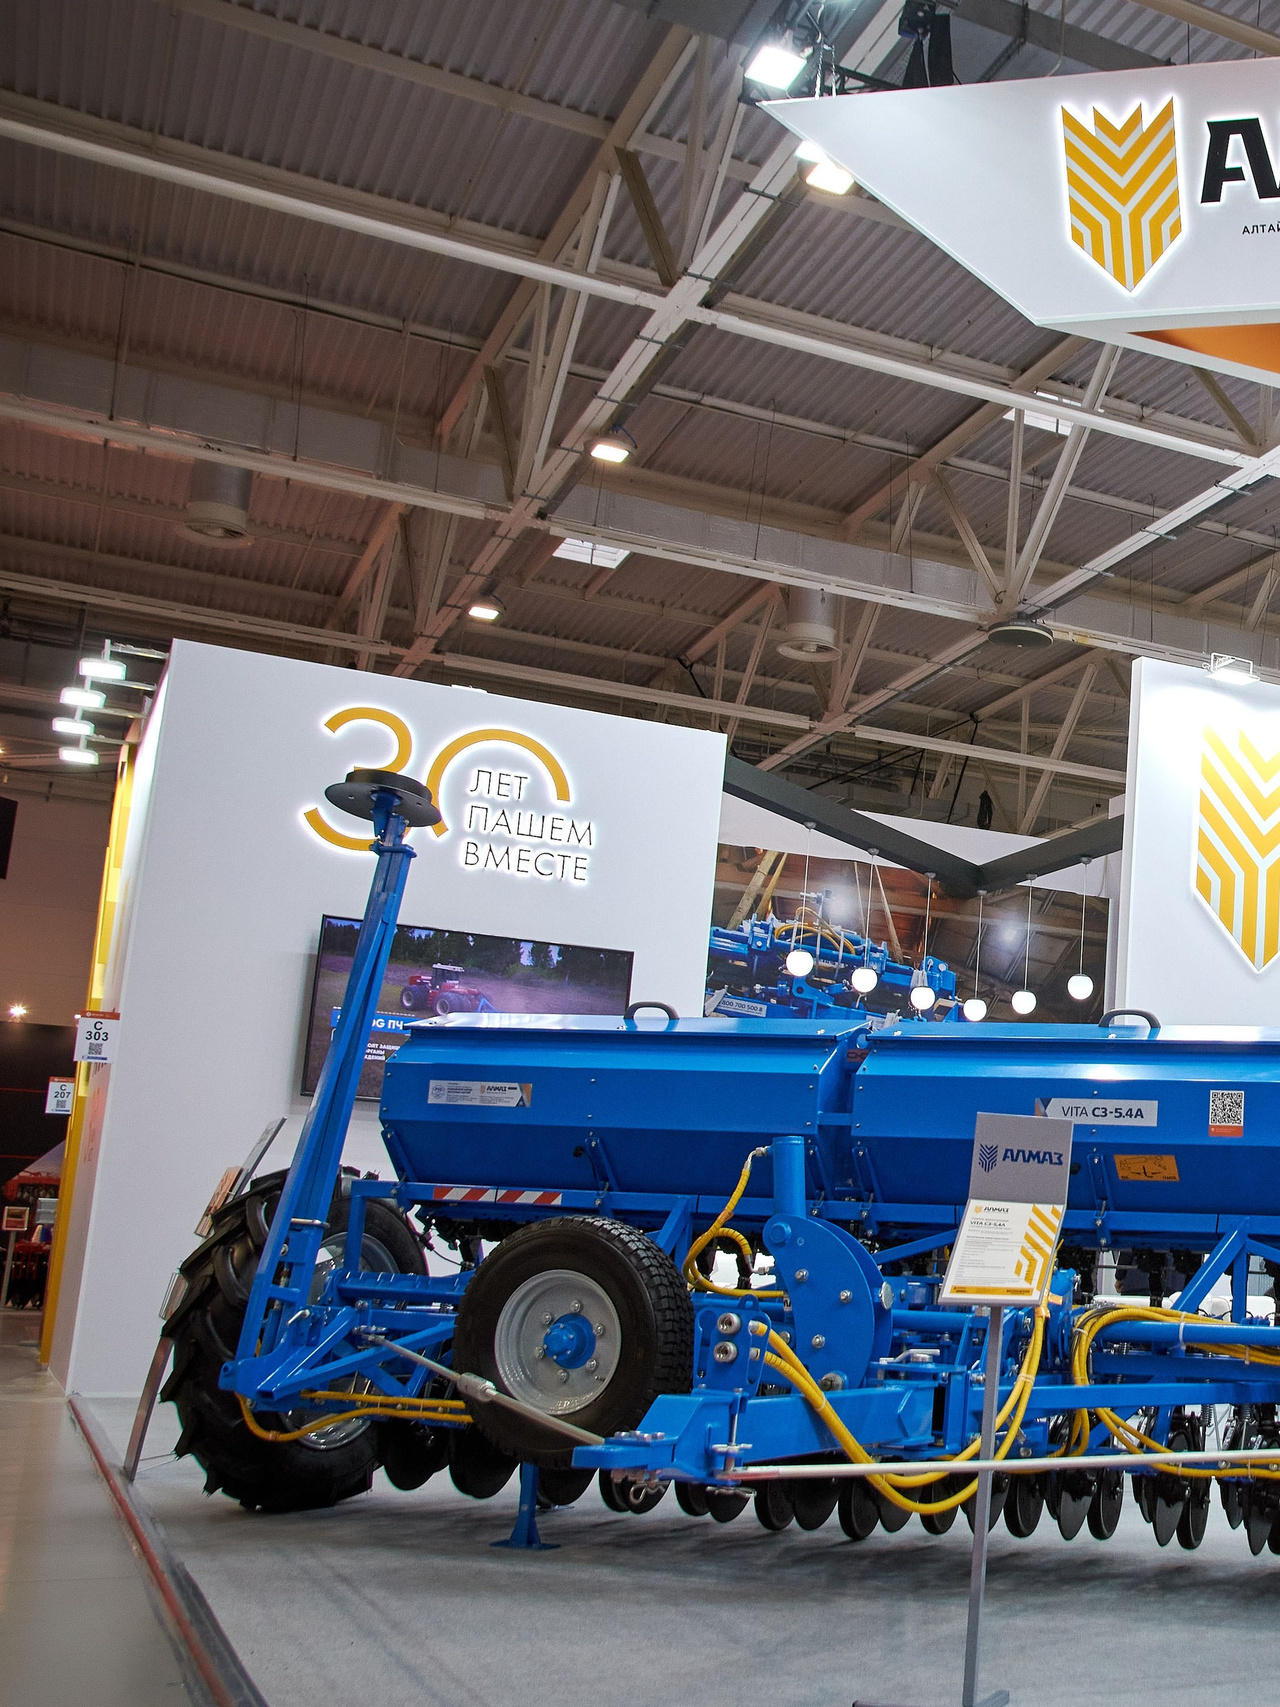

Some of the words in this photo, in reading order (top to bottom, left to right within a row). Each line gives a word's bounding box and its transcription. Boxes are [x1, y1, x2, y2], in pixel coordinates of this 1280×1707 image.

[469, 769, 529, 801] ЛЕТ
[468, 805, 593, 846] ПАШЕМ
[464, 842, 588, 881] ВМЕСТЕ
[85, 1031, 109, 1042] 303
[54, 1091, 71, 1099] 207
[1061, 1106, 1088, 1117] VITA
[1002, 1148, 1063, 1166] АЛМАЗ
